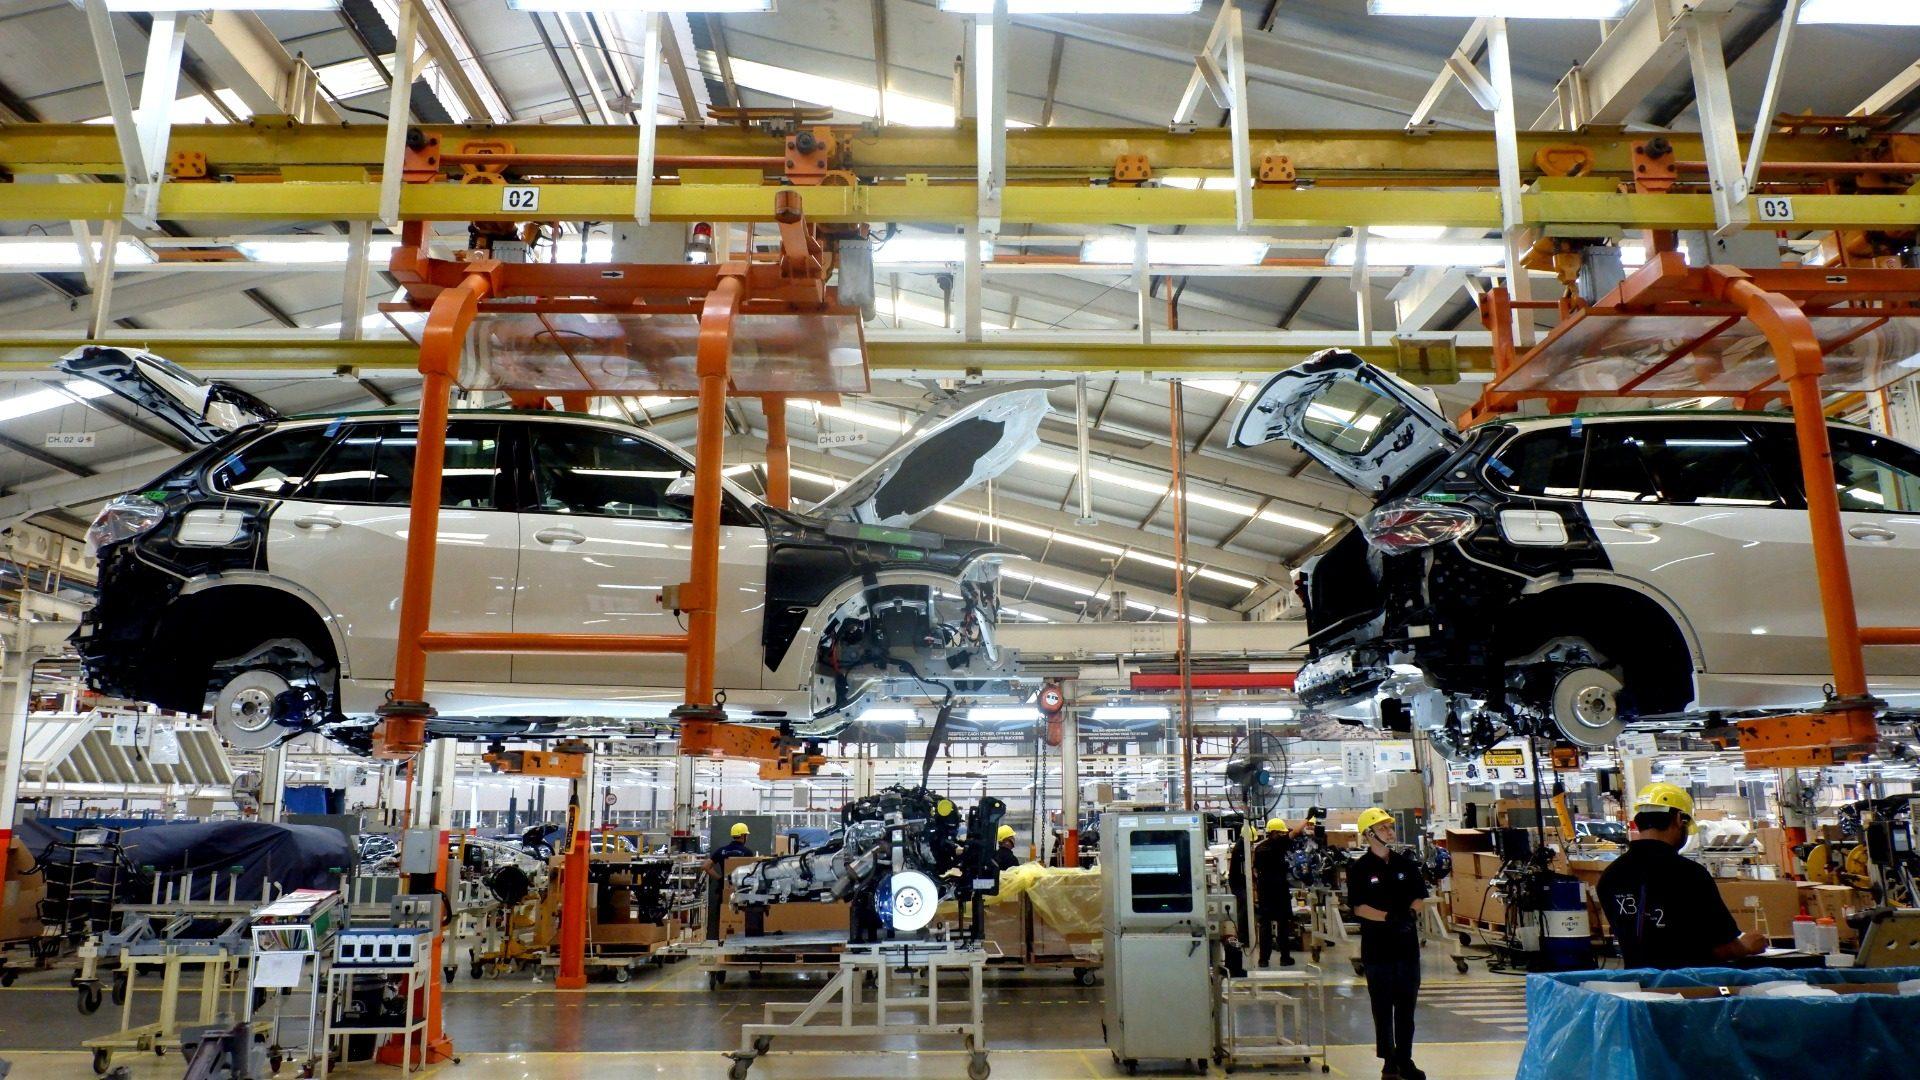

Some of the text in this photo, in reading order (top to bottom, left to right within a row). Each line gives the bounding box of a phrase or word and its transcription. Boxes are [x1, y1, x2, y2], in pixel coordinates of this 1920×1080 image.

[509, 190, 535, 208] 02
[1764, 200, 1789, 218] 03
[63, 436, 74, 444] 02
[835, 435, 846, 443] 03
[1615, 897, 1638, 915] X3
